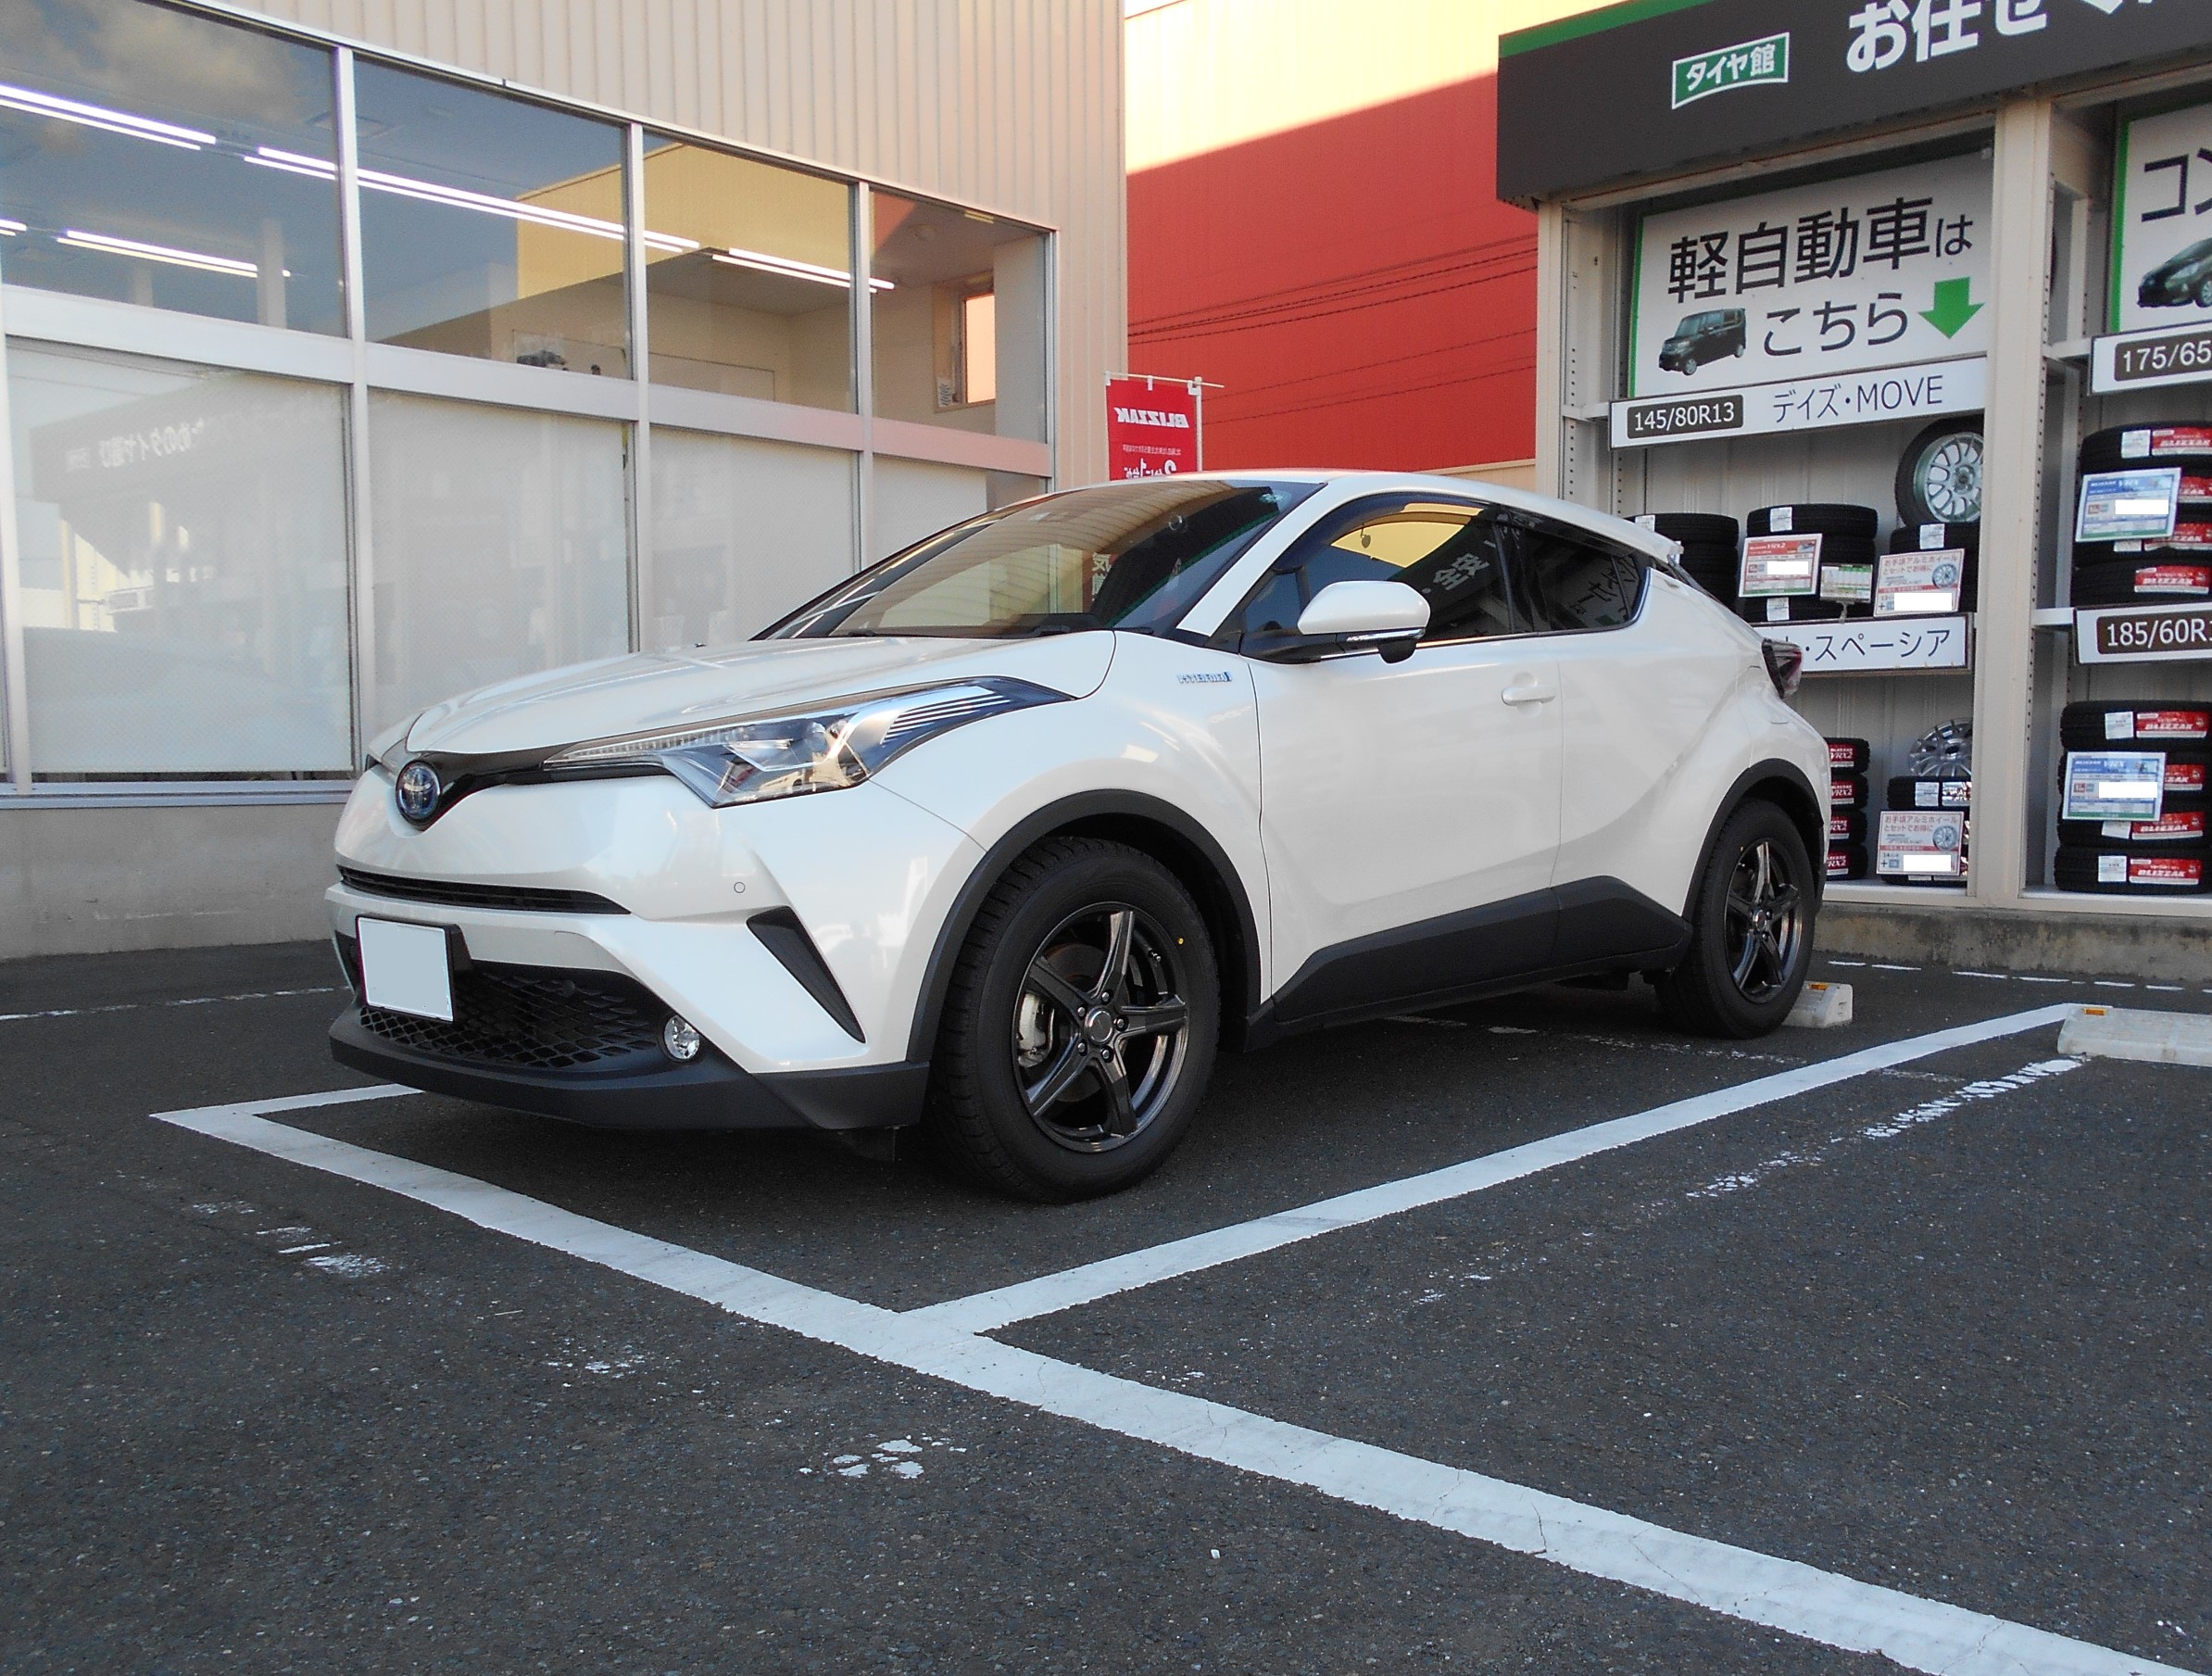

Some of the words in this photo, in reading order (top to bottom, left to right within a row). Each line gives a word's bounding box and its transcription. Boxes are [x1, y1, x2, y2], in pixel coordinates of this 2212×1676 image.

[1846, 0, 2154, 72] お任せ
[1686, 43, 1776, 92] タイヤ館
[1667, 196, 1974, 304] 軽自動車は
[1764, 293, 1908, 356] こちら
[2123, 339, 2212, 372] 175/65
[1634, 401, 1735, 431] 145/80R13
[2107, 617, 2212, 649] 185/60R
[1830, 751, 1853, 760] VRX2
[1830, 823, 1848, 831] RX2
